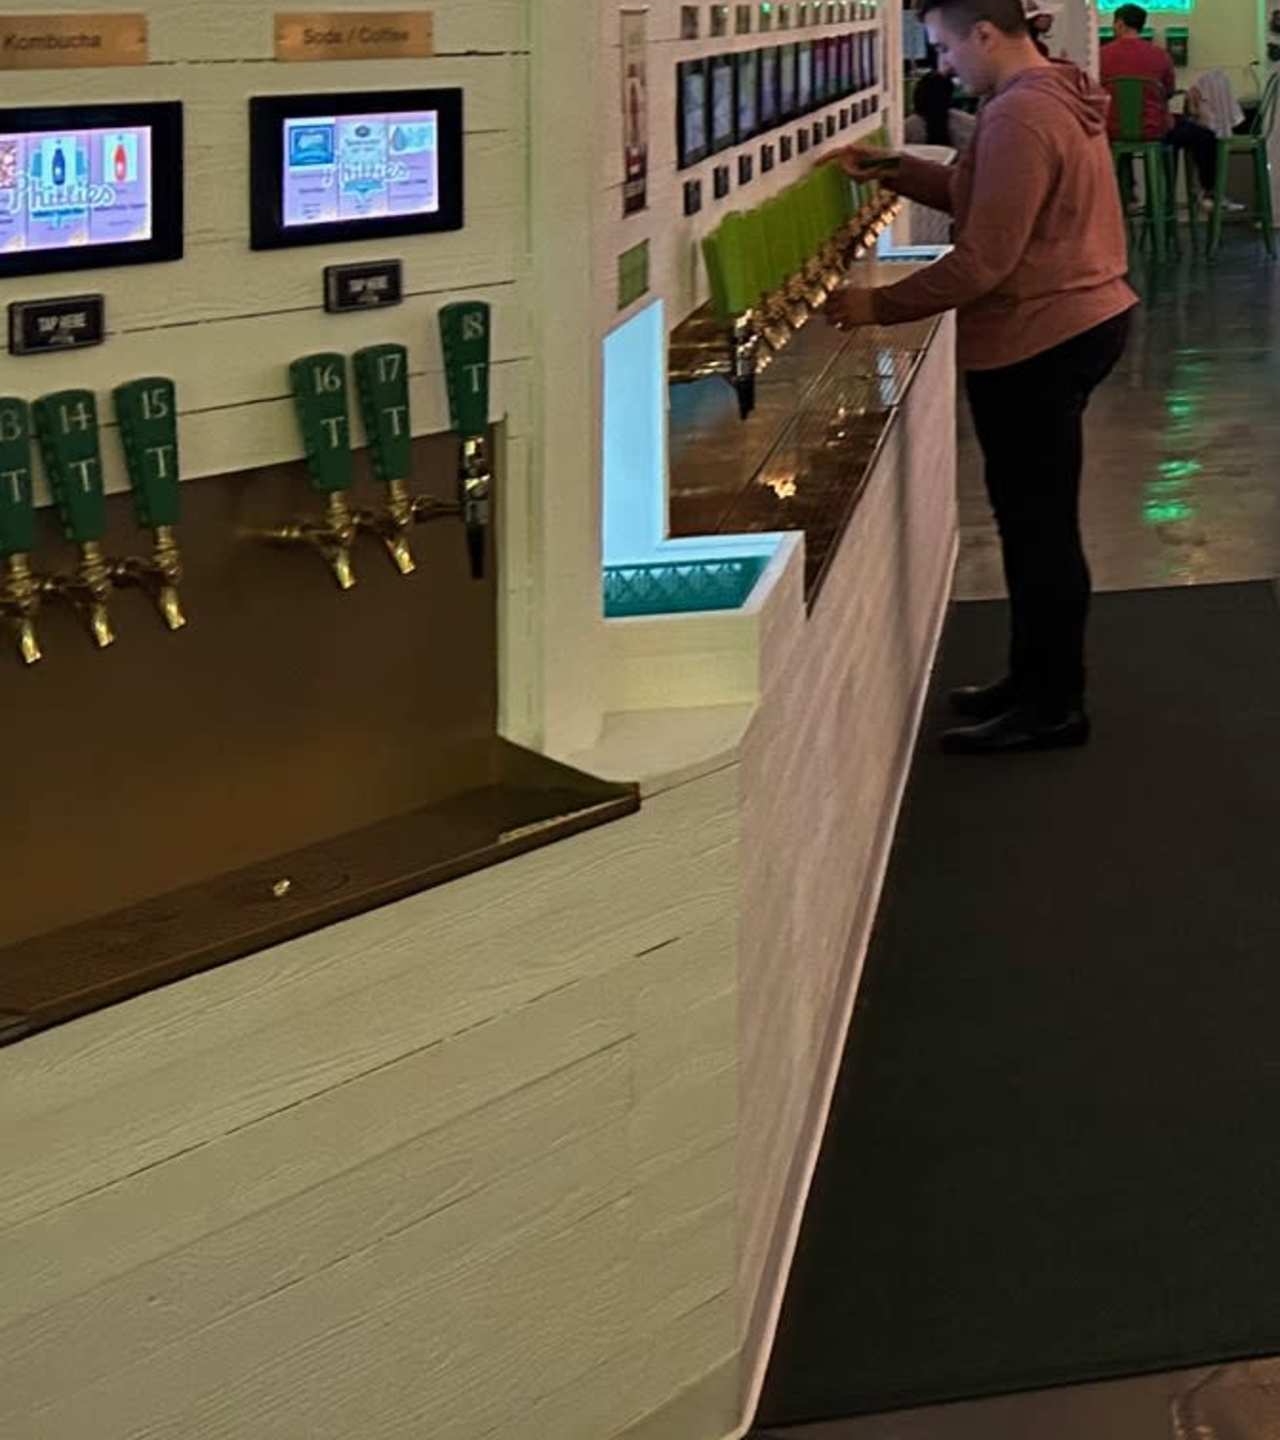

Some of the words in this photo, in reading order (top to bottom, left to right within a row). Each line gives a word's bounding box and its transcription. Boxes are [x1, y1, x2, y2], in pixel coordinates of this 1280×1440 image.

[3, 32, 102, 51] Kombucha
[303, 28, 342, 46] Soda
[37, 315, 59, 332] TAP
[59, 311, 88, 328] HERE
[313, 363, 342, 395] 16
[377, 353, 400, 383] 17
[463, 362, 486, 393] T
[60, 402, 93, 434] 14
[141, 388, 169, 421] 15
[320, 416, 345, 449] T
[381, 406, 406, 436] T
[69, 458, 96, 493] T
[146, 444, 174, 478] T
